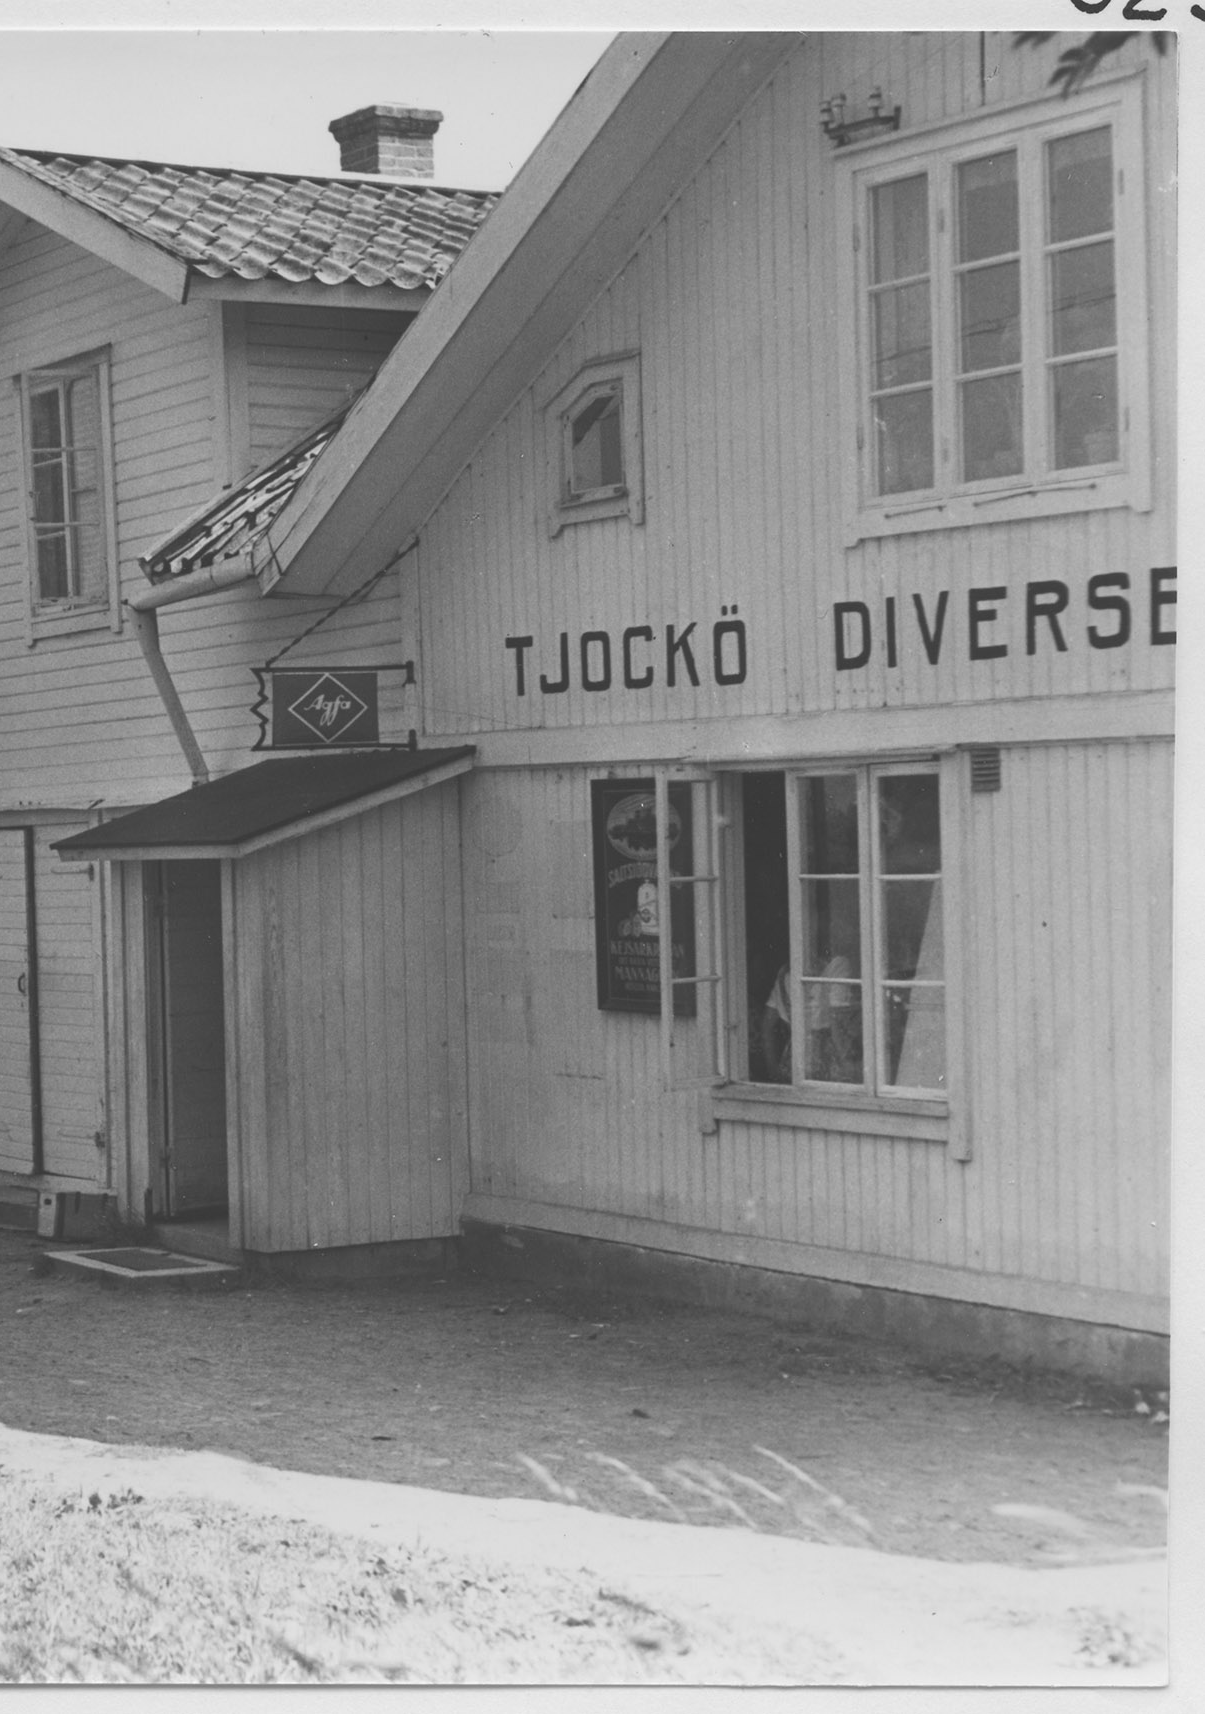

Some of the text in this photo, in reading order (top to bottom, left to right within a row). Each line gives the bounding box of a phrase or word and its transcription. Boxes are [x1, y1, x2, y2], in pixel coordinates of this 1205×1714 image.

[505, 566, 1177, 697] TJOCKÖ DIVERSE
[303, 694, 352, 727] Agfa
